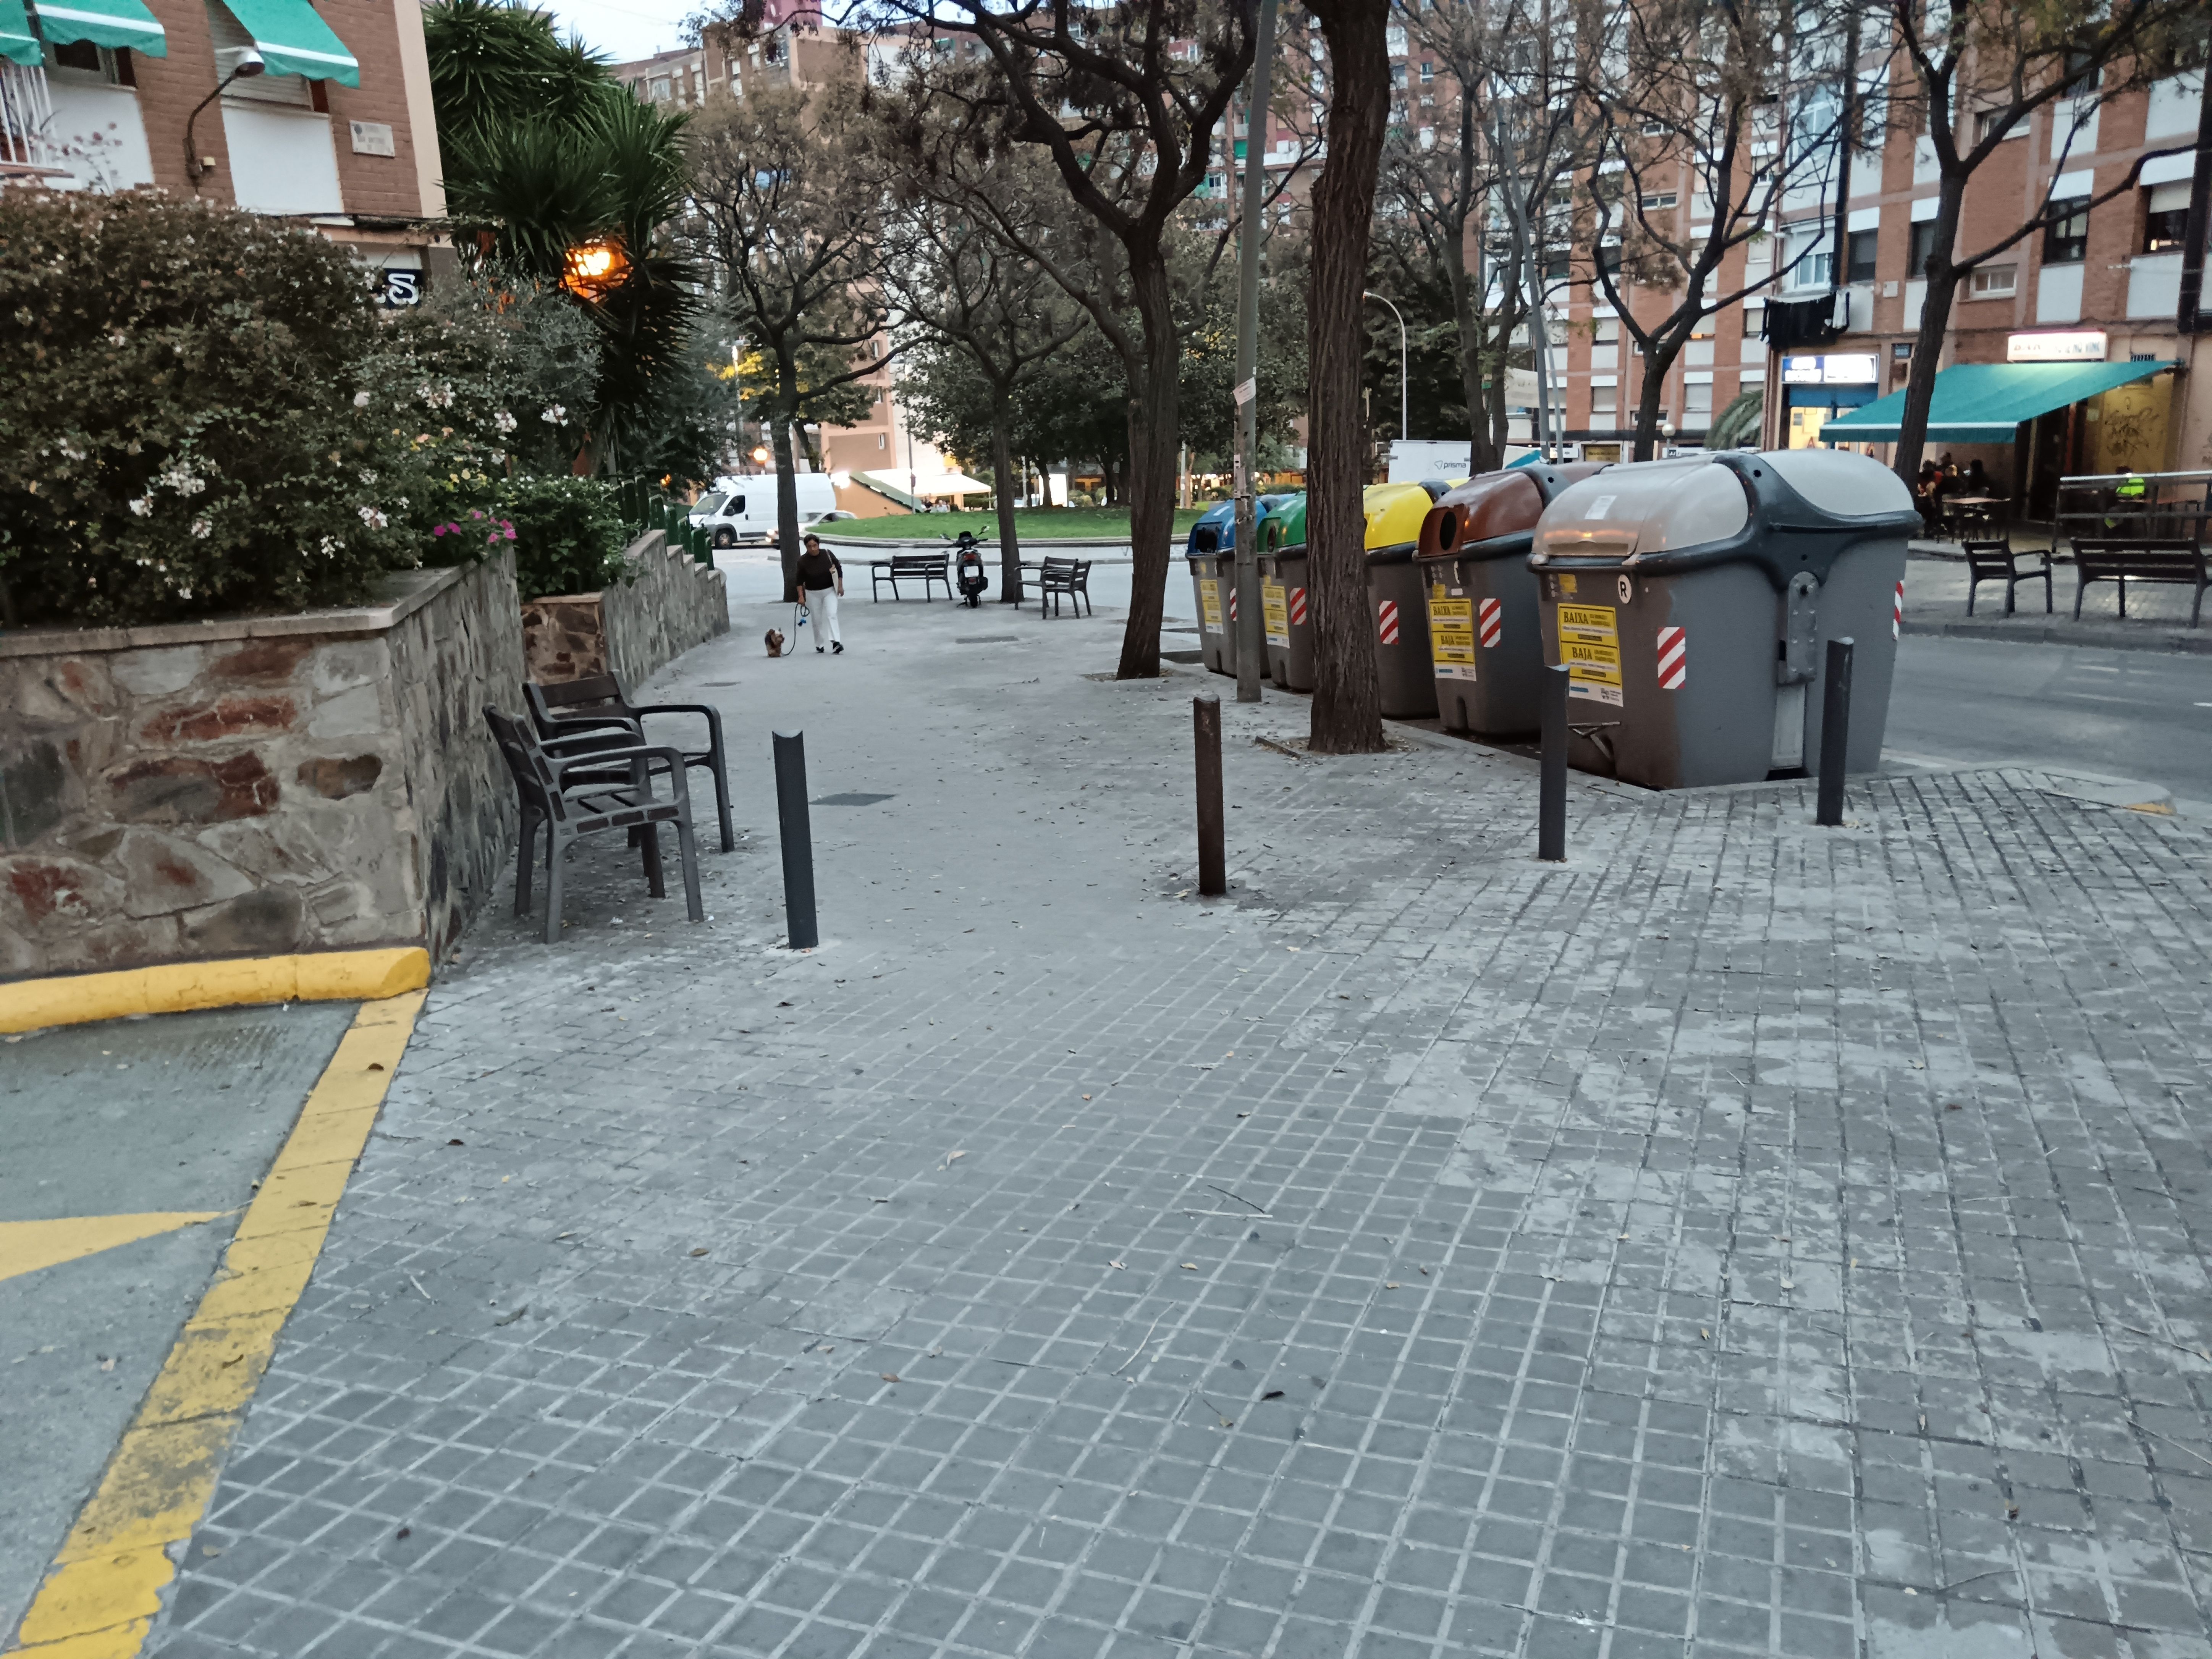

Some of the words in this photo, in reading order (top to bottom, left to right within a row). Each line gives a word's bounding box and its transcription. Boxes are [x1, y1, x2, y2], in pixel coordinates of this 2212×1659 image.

[1620, 581, 1627, 598] R
[1433, 606, 1451, 616] BAIXA
[1564, 611, 1589, 624] BAIXA
[1441, 635, 1455, 646] BAJA
[1572, 647, 1593, 661] BAJA
